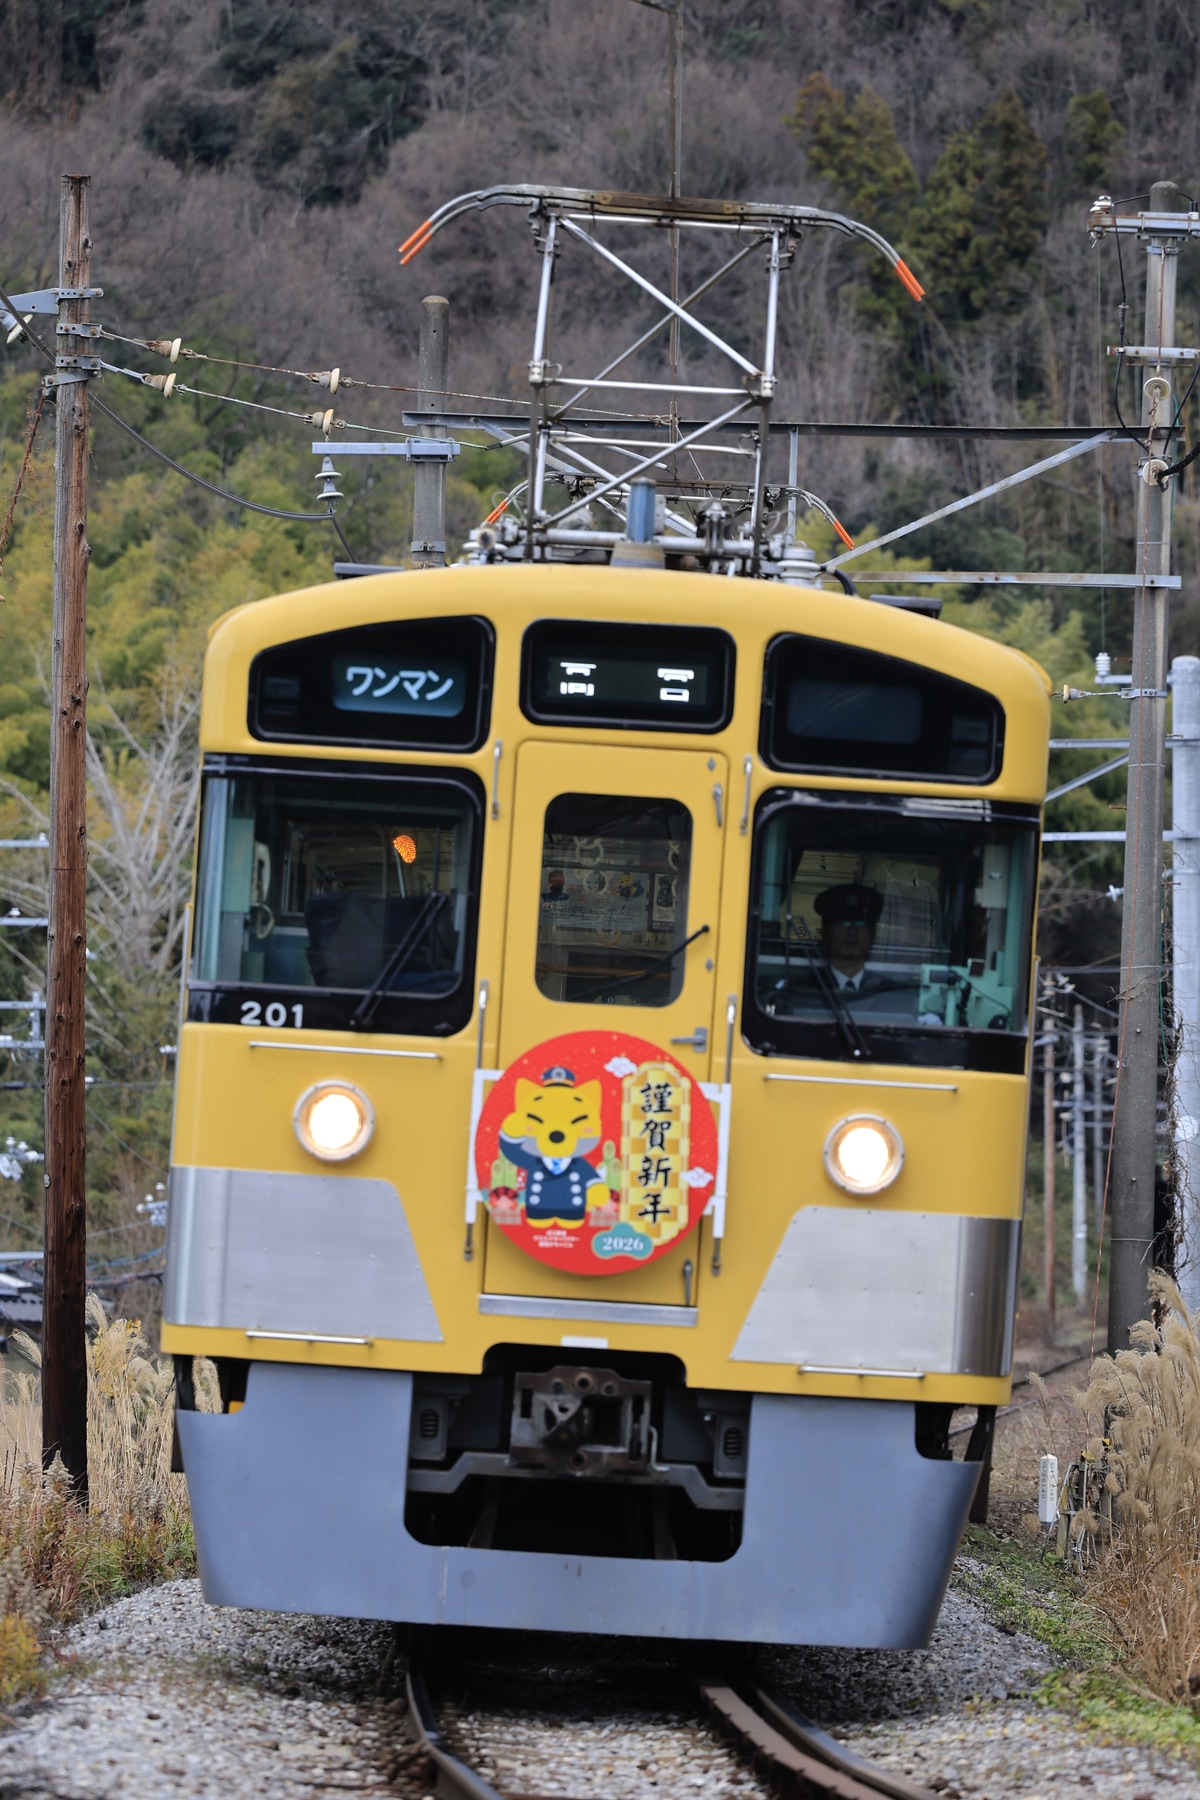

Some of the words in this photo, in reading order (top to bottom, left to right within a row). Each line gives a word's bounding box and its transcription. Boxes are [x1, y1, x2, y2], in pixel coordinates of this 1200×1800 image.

[346, 666, 454, 700] ワンマン
[241, 1000, 303, 1028] 201
[638, 1082, 673, 1225] 謹賀新年
[602, 1233, 645, 1252] 2026
